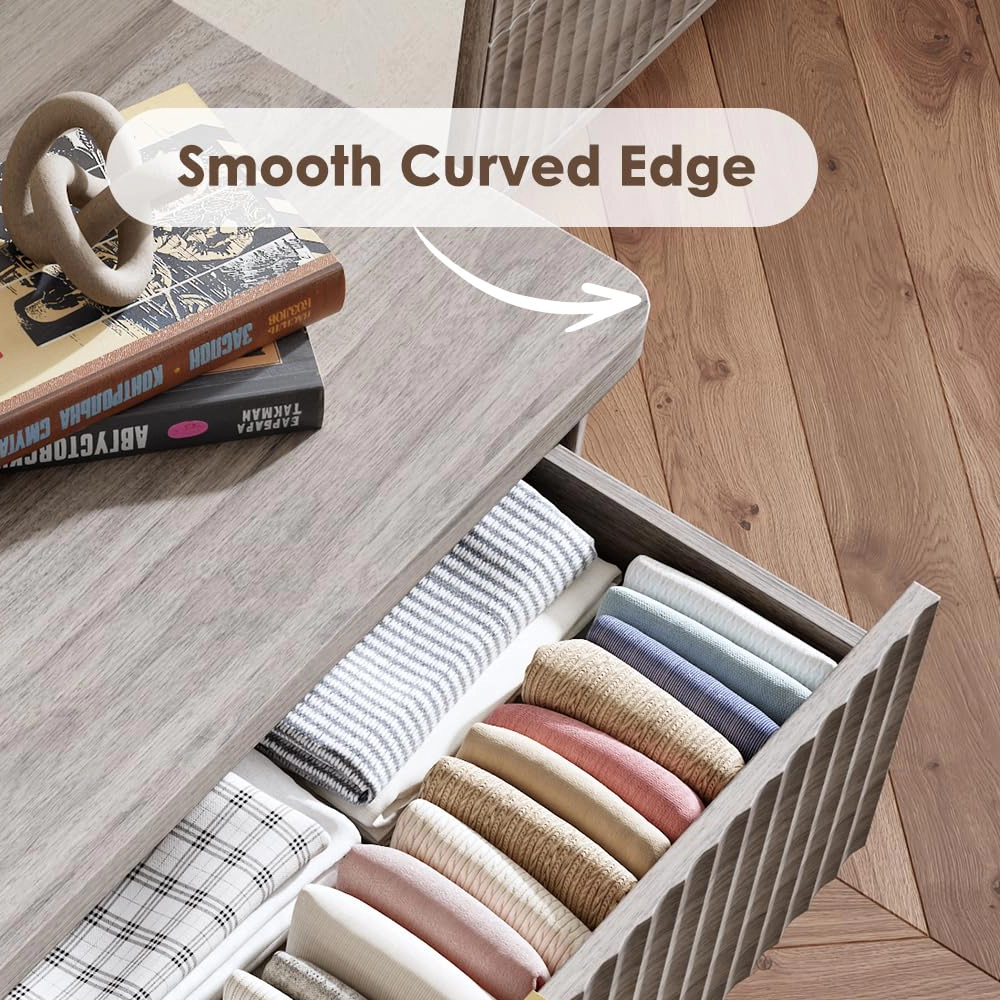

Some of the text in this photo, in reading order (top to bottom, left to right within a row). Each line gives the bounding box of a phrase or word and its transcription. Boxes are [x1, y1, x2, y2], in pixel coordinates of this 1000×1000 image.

[188, 322, 253, 371] ЗАСЛОН
[58, 363, 164, 429] КОНТРОЛЬНА
[242, 402, 303, 422] ТАКМАН
[236, 415, 300, 435] БАРБАРА
